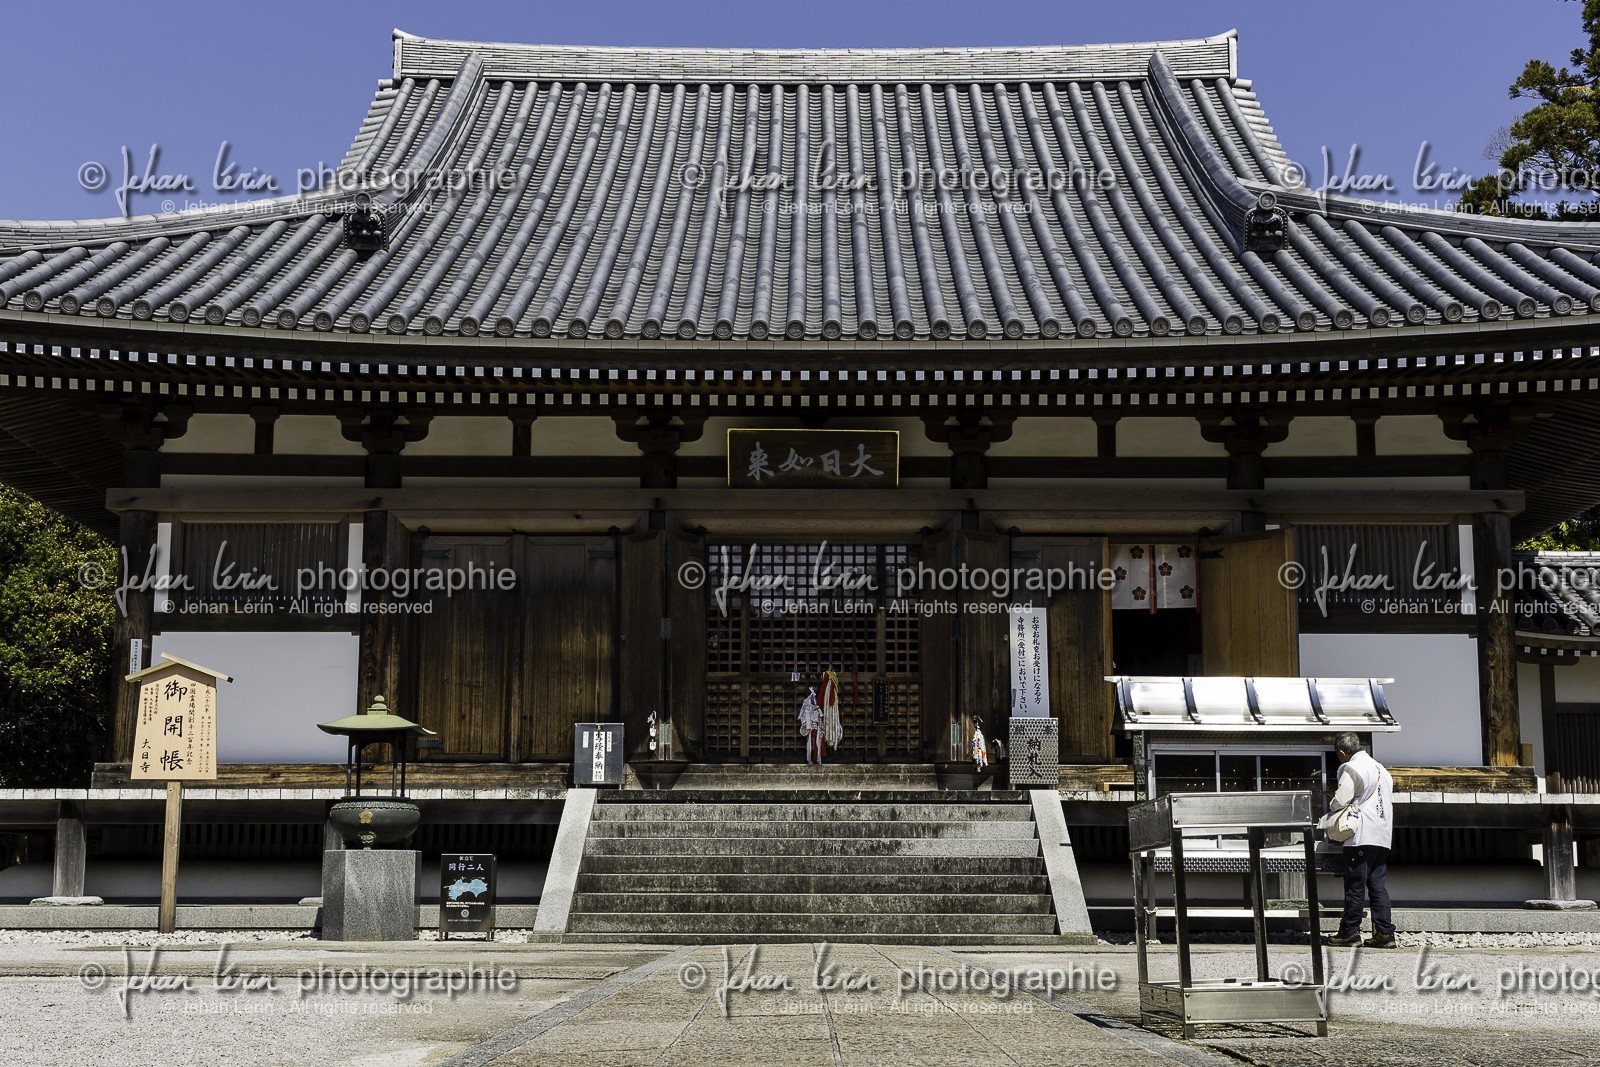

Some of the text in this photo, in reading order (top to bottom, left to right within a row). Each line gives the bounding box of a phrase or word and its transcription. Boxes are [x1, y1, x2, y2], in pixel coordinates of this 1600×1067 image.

[160, 680, 187, 772] 御開帳
[140, 739, 151, 773] 大日寺
[448, 862, 485, 871] 同行二人
